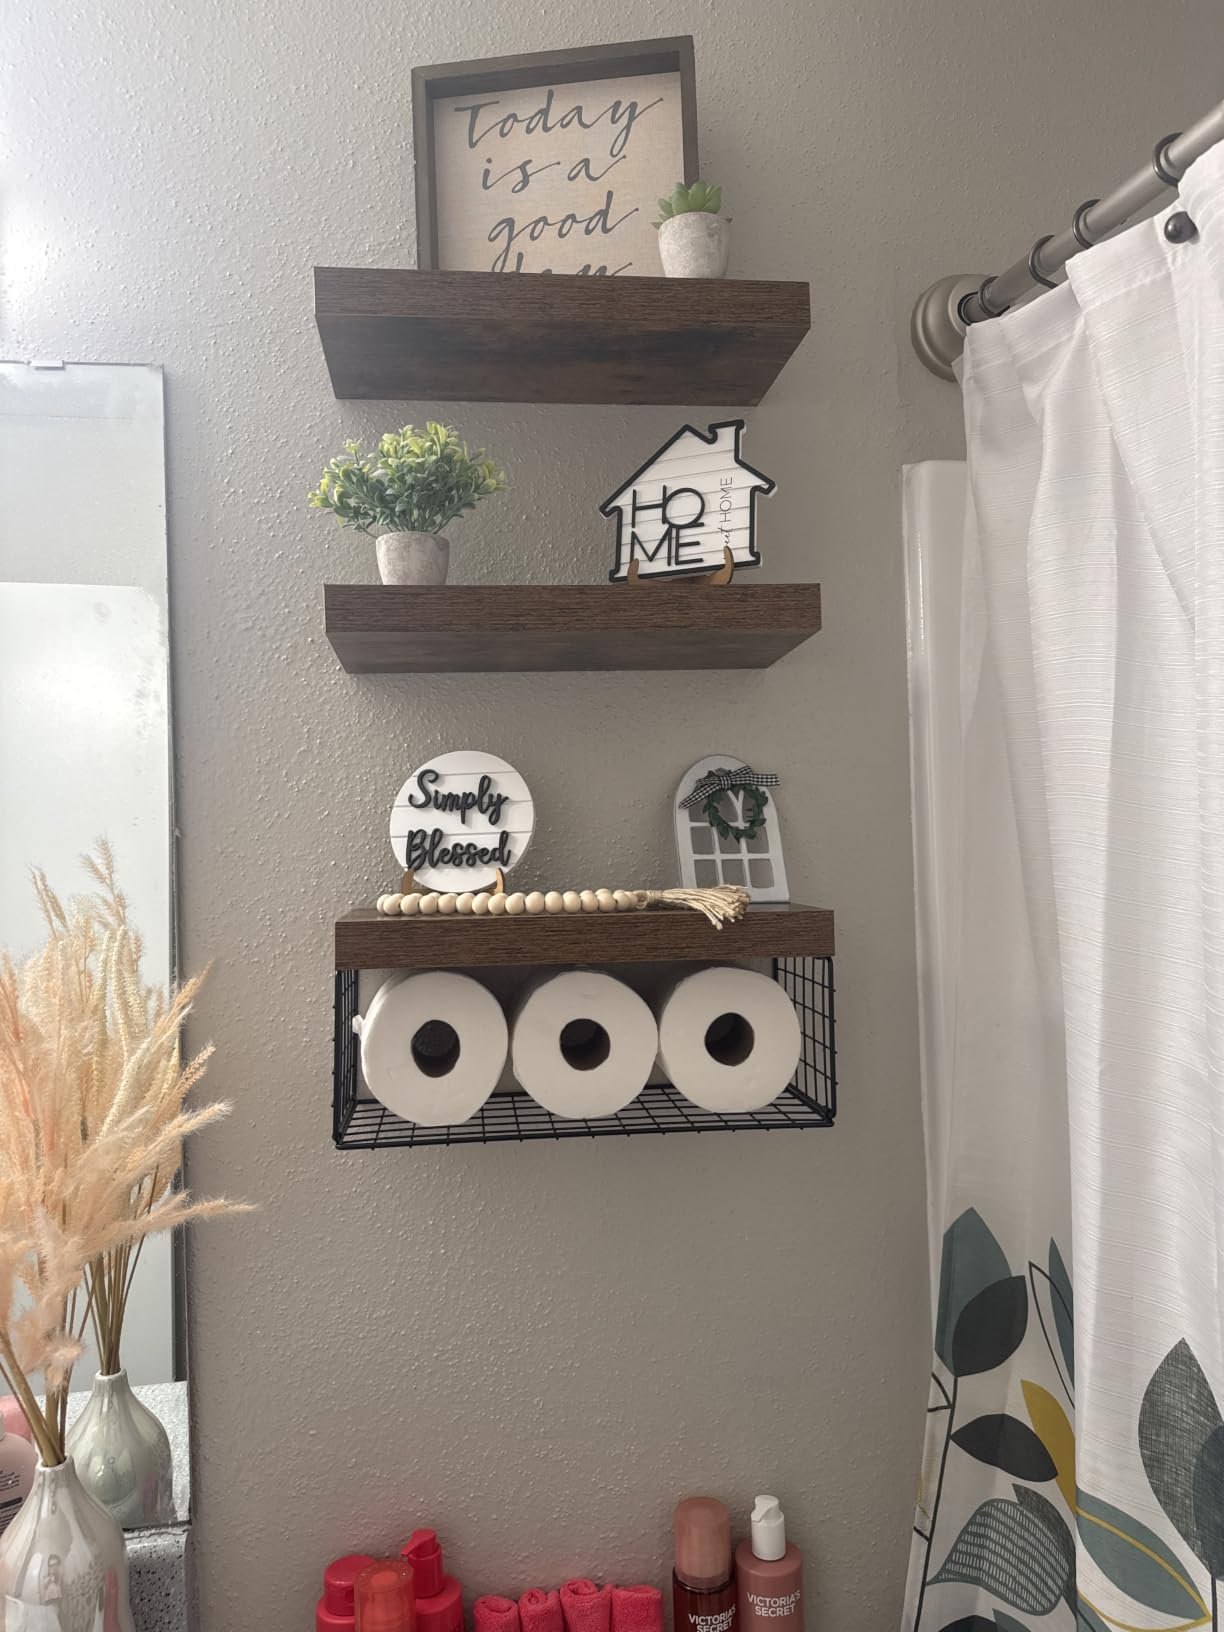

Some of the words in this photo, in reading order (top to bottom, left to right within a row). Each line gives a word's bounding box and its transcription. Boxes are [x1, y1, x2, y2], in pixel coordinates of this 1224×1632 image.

[454, 89, 664, 157] Today
[482, 157, 560, 193] is
[567, 155, 627, 182] a
[487, 190, 639, 272] good
[719, 476, 733, 523] HOME
[408, 769, 509, 825] Simply
[405, 828, 511, 872] Blessed
[688, 1604, 736, 1626] VICTORIA'S
[746, 1589, 801, 1608] VICTORIA'S
[755, 1602, 796, 1617] SECRET
[696, 1617, 733, 1632] SECRET
